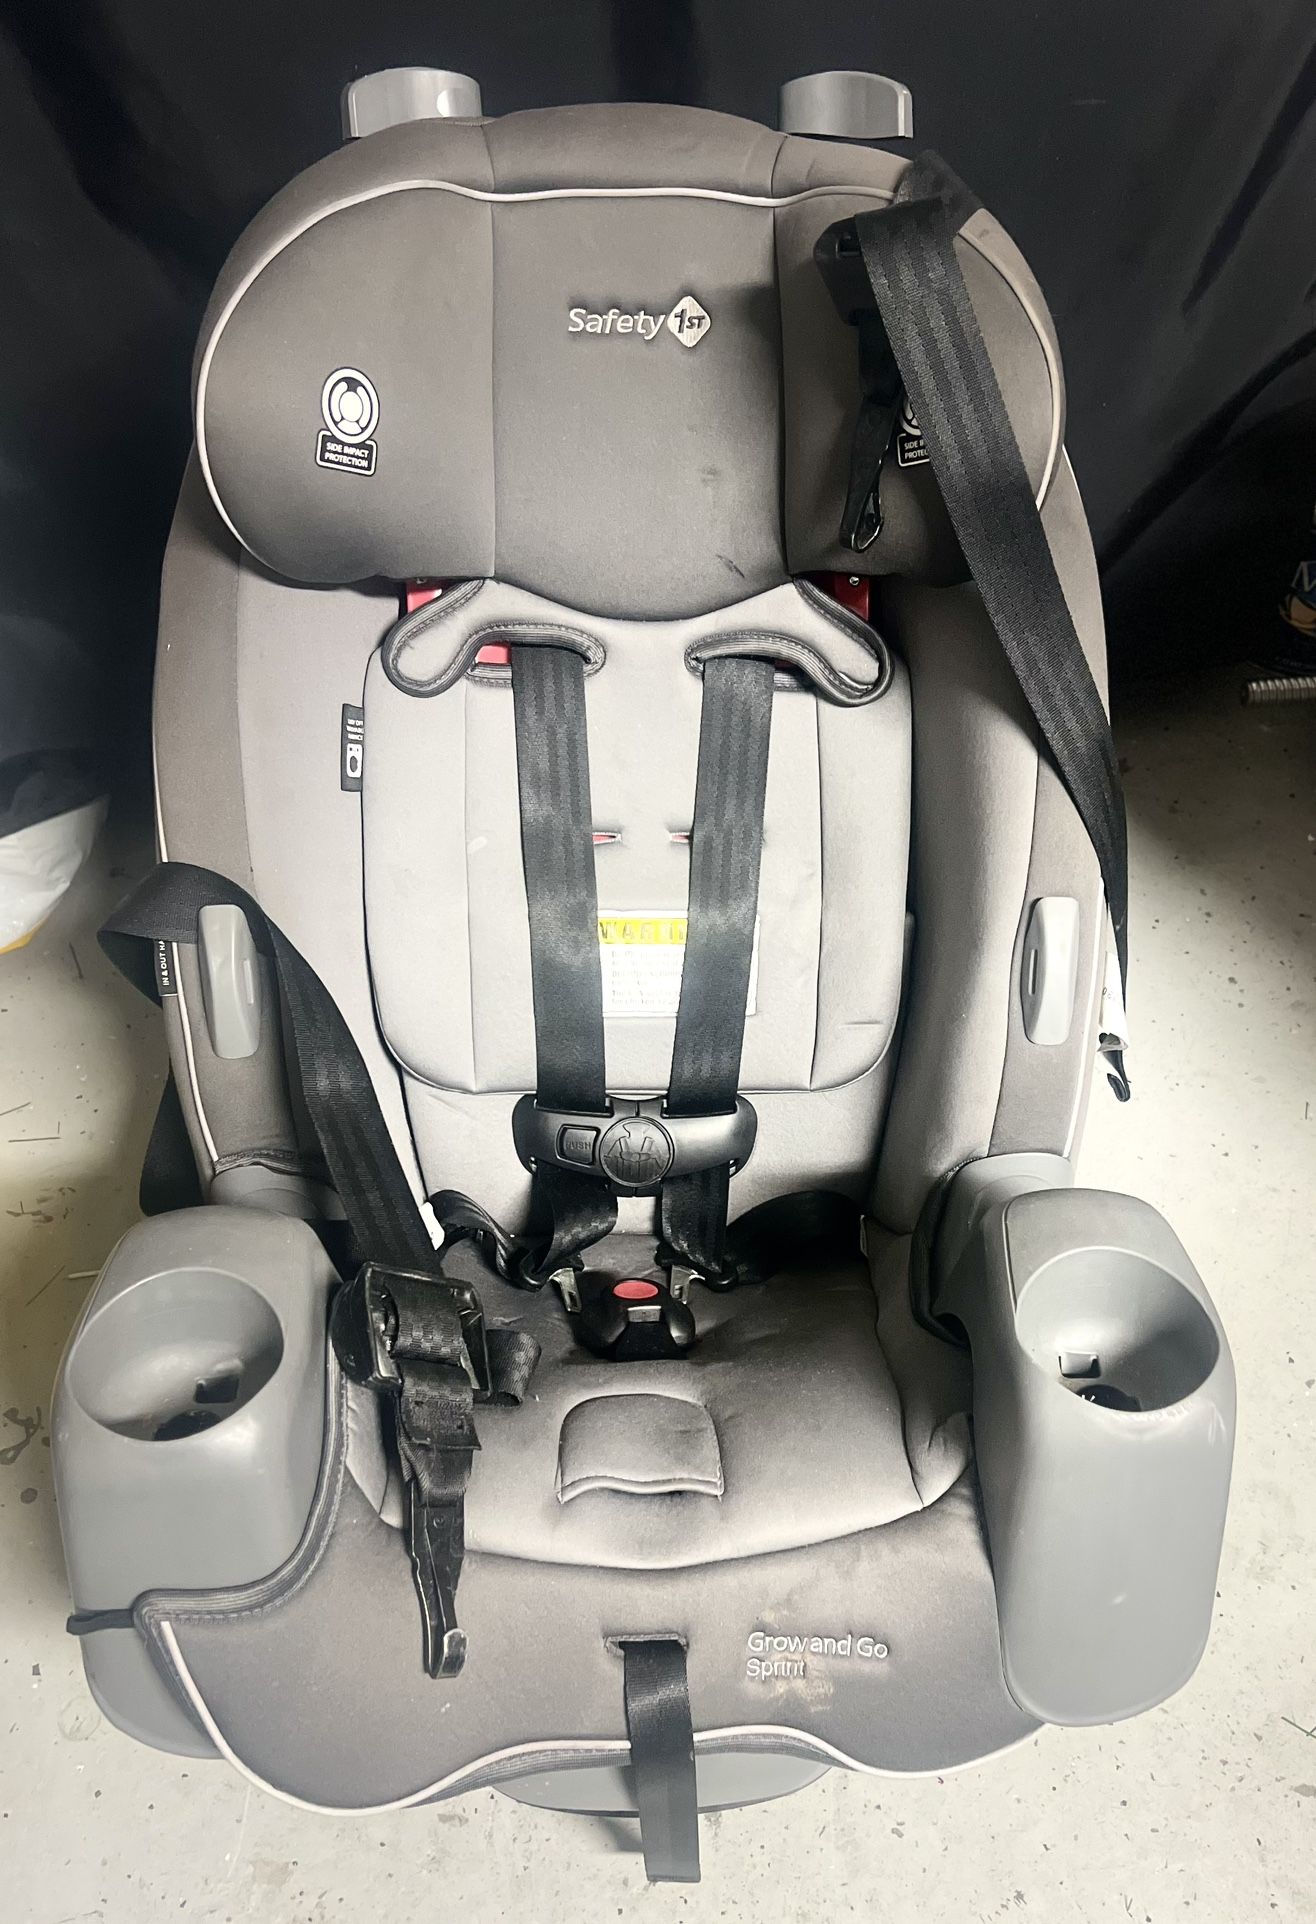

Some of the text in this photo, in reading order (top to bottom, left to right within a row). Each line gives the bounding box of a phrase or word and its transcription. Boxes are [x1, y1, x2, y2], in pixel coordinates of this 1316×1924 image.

[567, 308, 666, 340] Safety
[326, 442, 370, 458] SIDE IMPACT
[904, 440, 919, 450] SIDE
[324, 452, 369, 468] PROTECTION
[159, 952, 168, 970] OUT
[162, 977, 170, 986] IN
[747, 1631, 889, 1659] Grow and Go
[746, 1658, 805, 1681] Sprint
